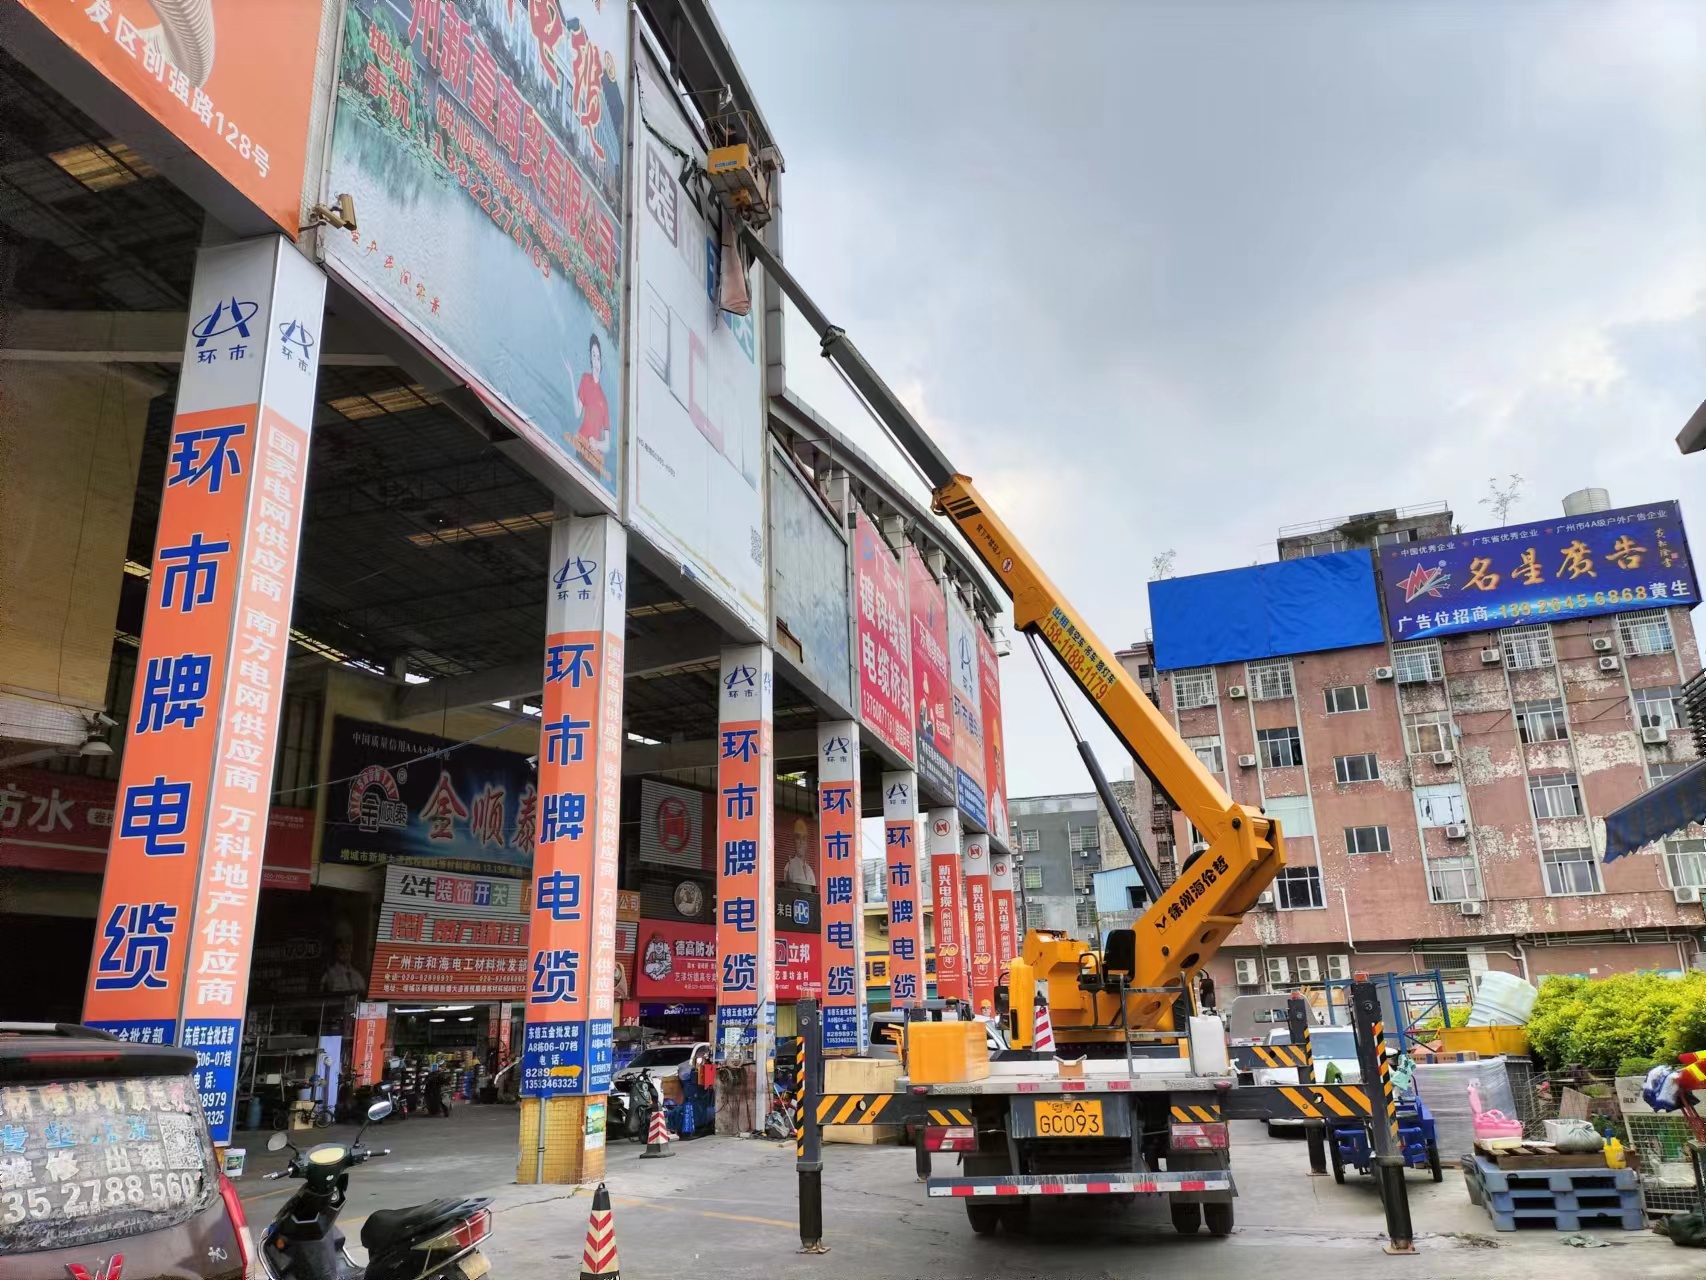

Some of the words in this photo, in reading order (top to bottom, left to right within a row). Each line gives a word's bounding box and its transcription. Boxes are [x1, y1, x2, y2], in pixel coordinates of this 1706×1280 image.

[72, 0, 271, 178] 发区创强路128号
[197, 344, 248, 364] 环市
[281, 344, 310, 372] 环市
[250, 425, 300, 602] 国家电网供应商
[1400, 541, 1456, 557] 中国优秀企业
[1472, 528, 1539, 546] 广东省优秀企业
[1556, 509, 1668, 534] 广州市4A级户外广告企业
[557, 588, 592, 601] 环市
[1499, 602, 1532, 620] 139
[1538, 592, 1590, 615] 2645
[1594, 585, 1649, 606] 6868
[1649, 579, 1691, 599] 黄生
[1052, 607, 1069, 628] 出租
[862, 632, 911, 723] 电缆桥架
[1043, 617, 1109, 700] 158-1188-1179
[95, 423, 246, 991] 环市牌电缆
[223, 606, 281, 795] 南方电网供应商
[728, 689, 754, 698] 环市
[531, 642, 596, 1004] 环市牌电缆
[721, 729, 758, 992] 环市牌电缆
[196, 803, 257, 1006] 万科地产供应商
[400, 874, 508, 907] 公牛装饰开关
[620, 894, 639, 911] 公司
[822, 788, 855, 996] 环市牌电缆
[938, 865, 952, 908] 新兴电缆
[972, 884, 985, 922] 新兴电缆
[1168, 855, 1229, 921] 徐州海伦哲
[776, 902, 792, 917] 来自
[794, 901, 809, 921] PPG
[886, 827, 917, 998] 环市牌电缆
[386, 954, 529, 972] 广州市和海电工材料批发部
[675, 940, 715, 957] 德高防水
[788, 943, 810, 963] 立邦
[184, 1025, 235, 1046] 东信五金批发部
[527, 1041, 578, 1053] A8栋06-07档
[528, 1025, 579, 1038] 东信五金批发部
[1040, 1114, 1100, 1133] GC093
